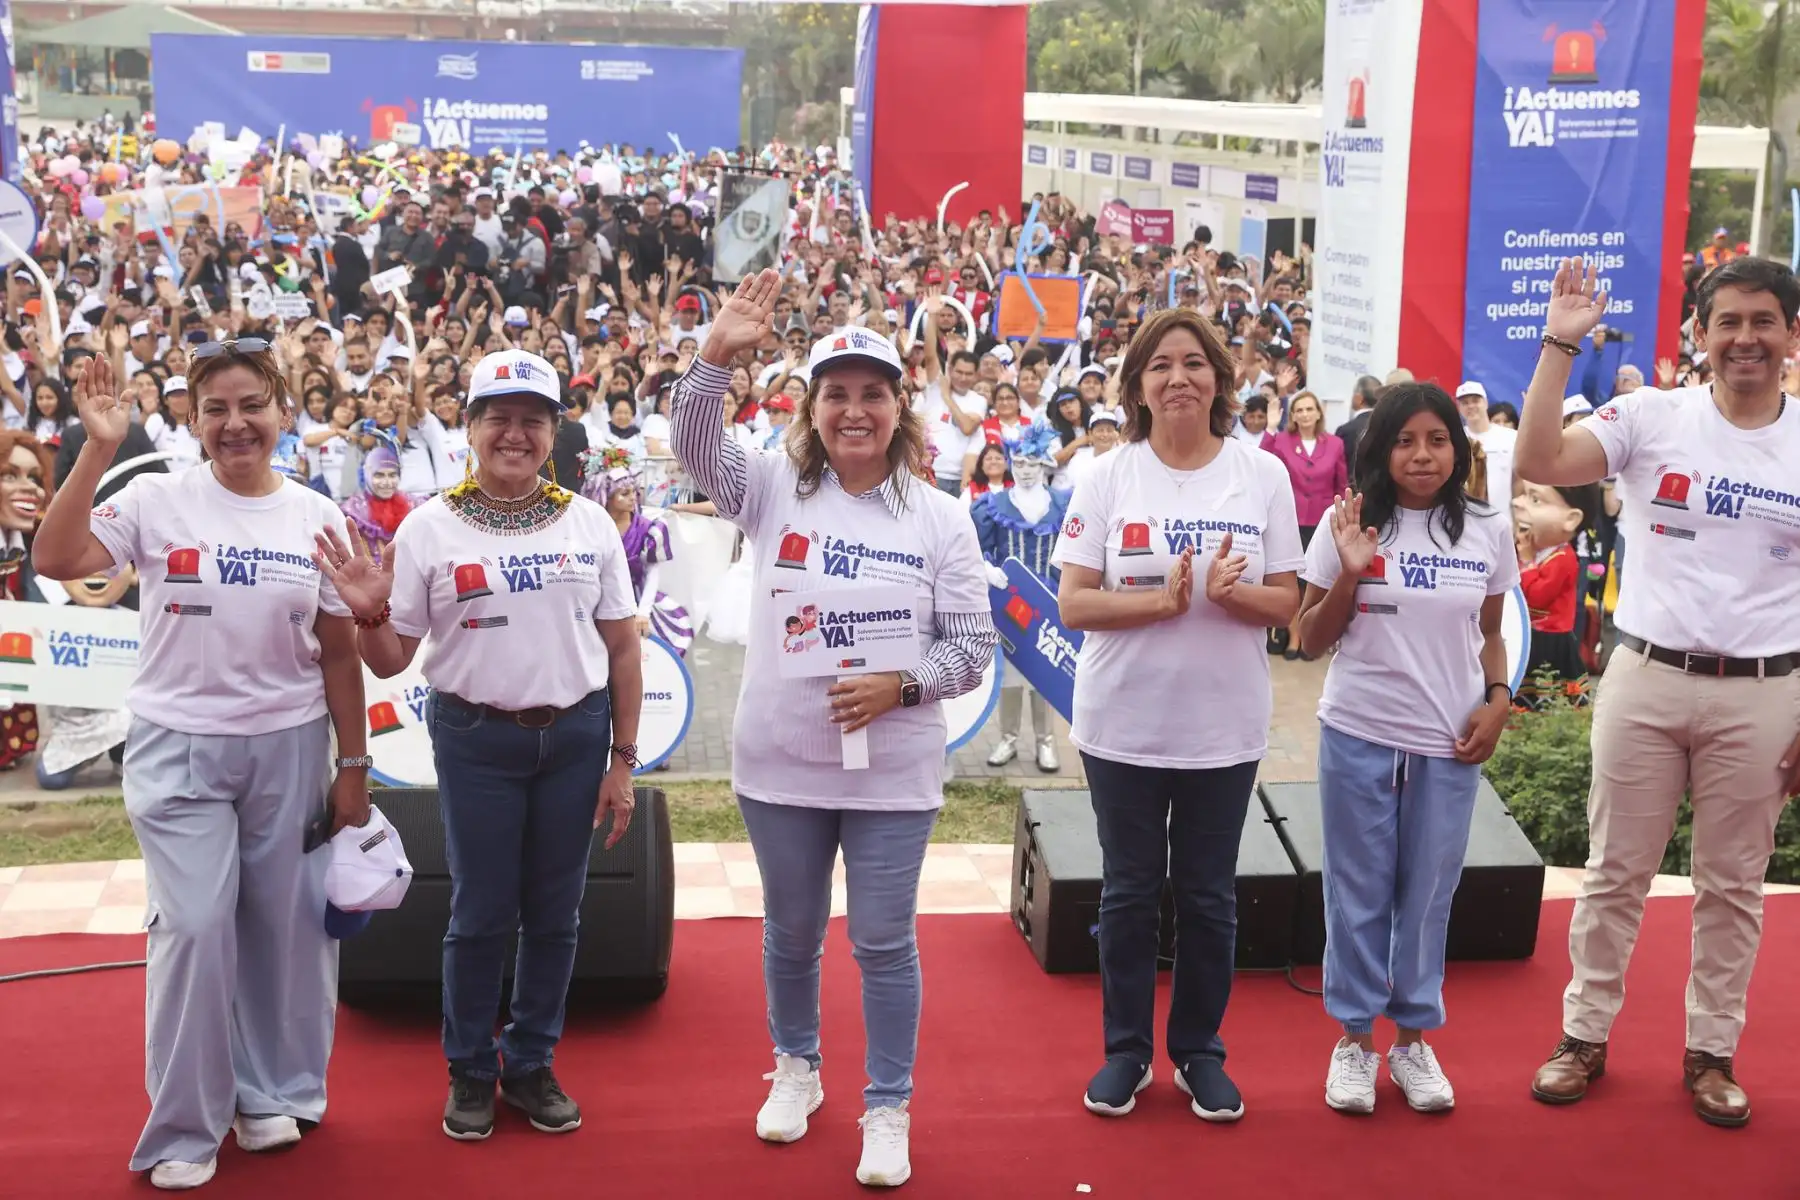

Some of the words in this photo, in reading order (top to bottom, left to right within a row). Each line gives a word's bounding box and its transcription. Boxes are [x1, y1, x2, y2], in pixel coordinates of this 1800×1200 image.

[423, 97, 548, 120] ¡Actuemos
[1504, 86, 1640, 110] ¡Actuemos
[423, 119, 471, 150] YA!
[1503, 111, 1555, 147] YA!
[1325, 130, 1384, 153] ¡Actuemos
[1324, 154, 1345, 187] YA!
[1504, 229, 1598, 248] Confiemos
[1602, 231, 1624, 246] en
[1583, 251, 1624, 272] hijas
[1512, 276, 1527, 294] si
[1506, 325, 1537, 339] con
[852, 339, 867, 349] YA!
[515, 368, 531, 380] YA!
[1705, 491, 1745, 520] YA!
[1164, 518, 1260, 536] ¡Actuemos
[823, 535, 924, 569] ¡Actuemos
[1164, 532, 1202, 555] YA!
[216, 543, 319, 571] ¡Actuemos
[822, 551, 861, 580] YA!
[1399, 552, 1488, 573] ¡Actuemo
[216, 558, 258, 586] YA!
[500, 567, 543, 593] YA!
[1399, 566, 1437, 590] YA!
[819, 608, 912, 626] ¡Actuemos
[48, 630, 139, 651] ¡Actuem
[820, 626, 855, 649] YA!
[49, 644, 90, 668] YA!
